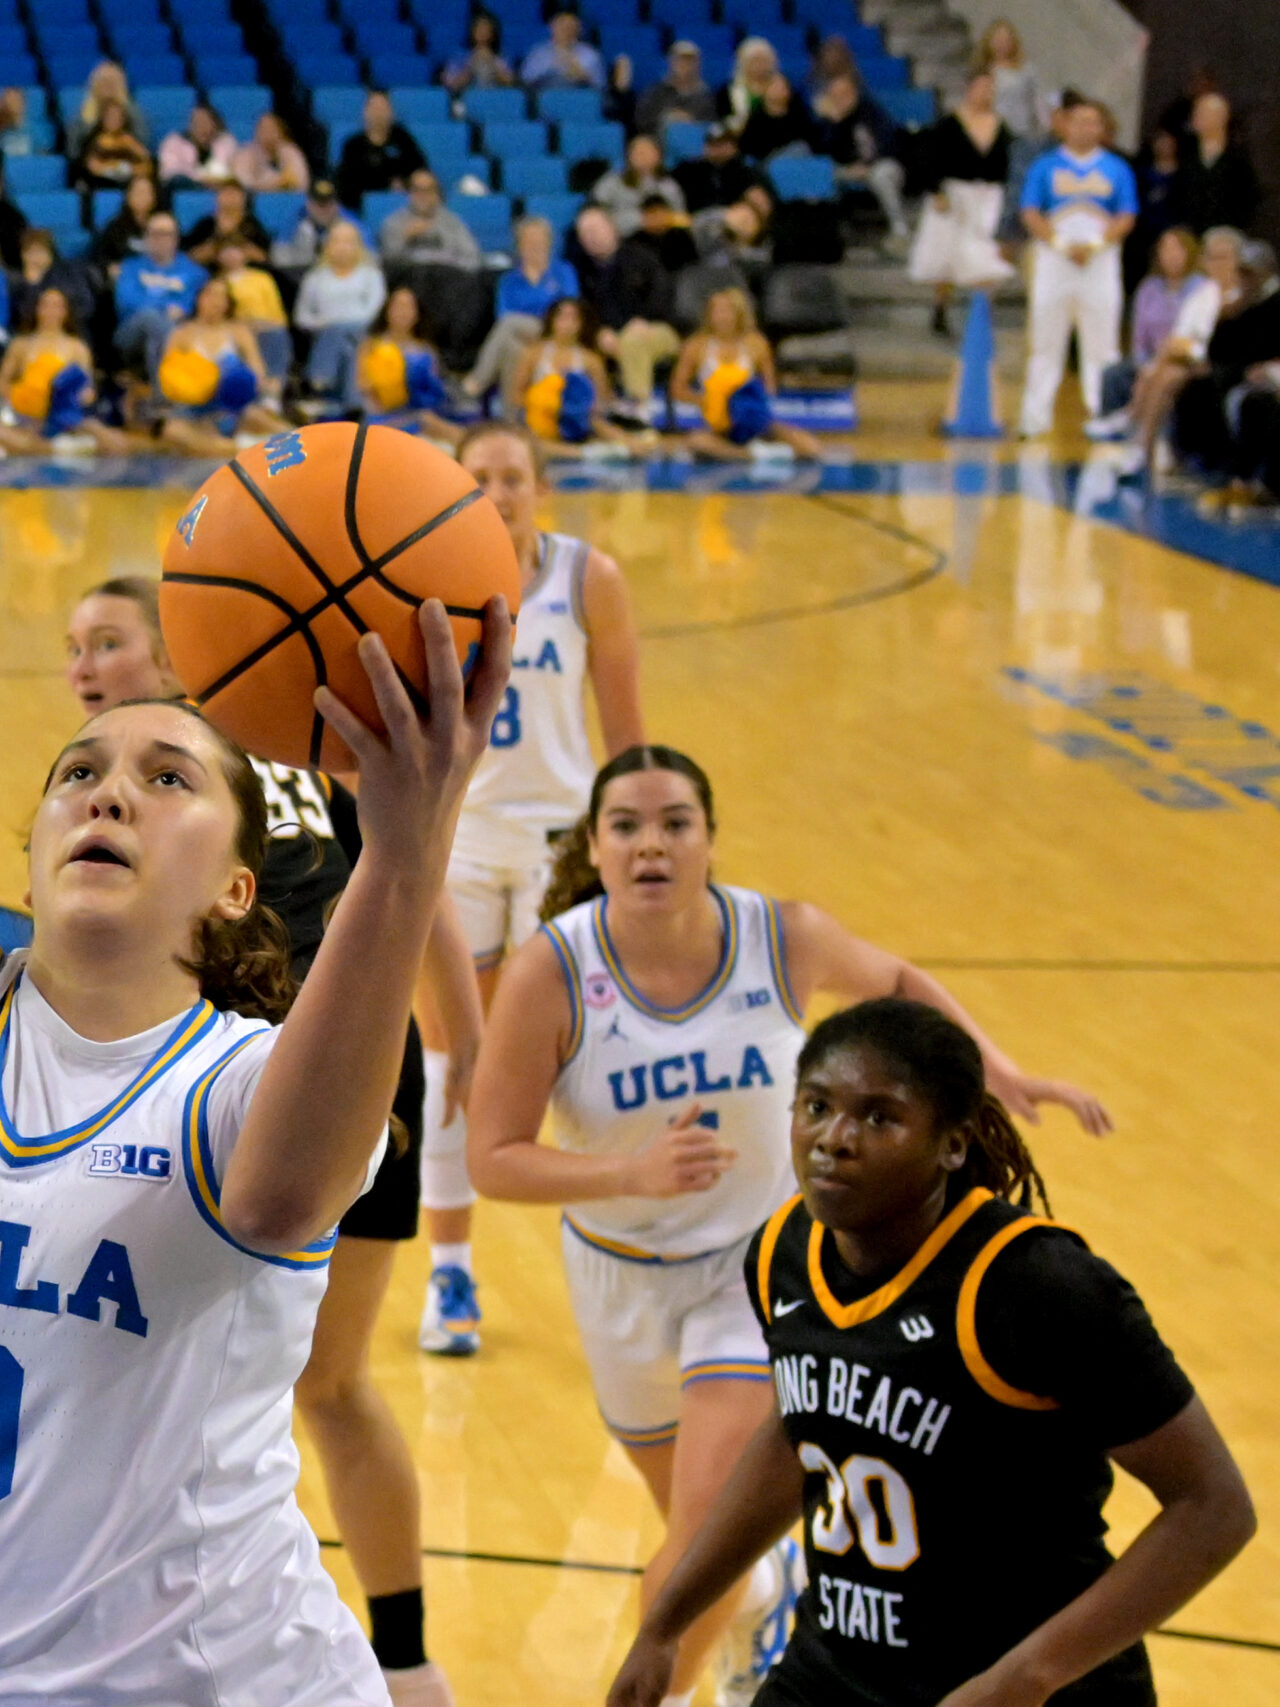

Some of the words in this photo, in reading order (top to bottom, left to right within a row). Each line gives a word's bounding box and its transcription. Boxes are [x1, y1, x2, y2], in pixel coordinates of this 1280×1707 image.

[607, 1045, 774, 1113] UCLA
[827, 1357, 952, 1456] BEACH
[797, 1440, 921, 1571] 30
[819, 1573, 910, 1648] STATE
